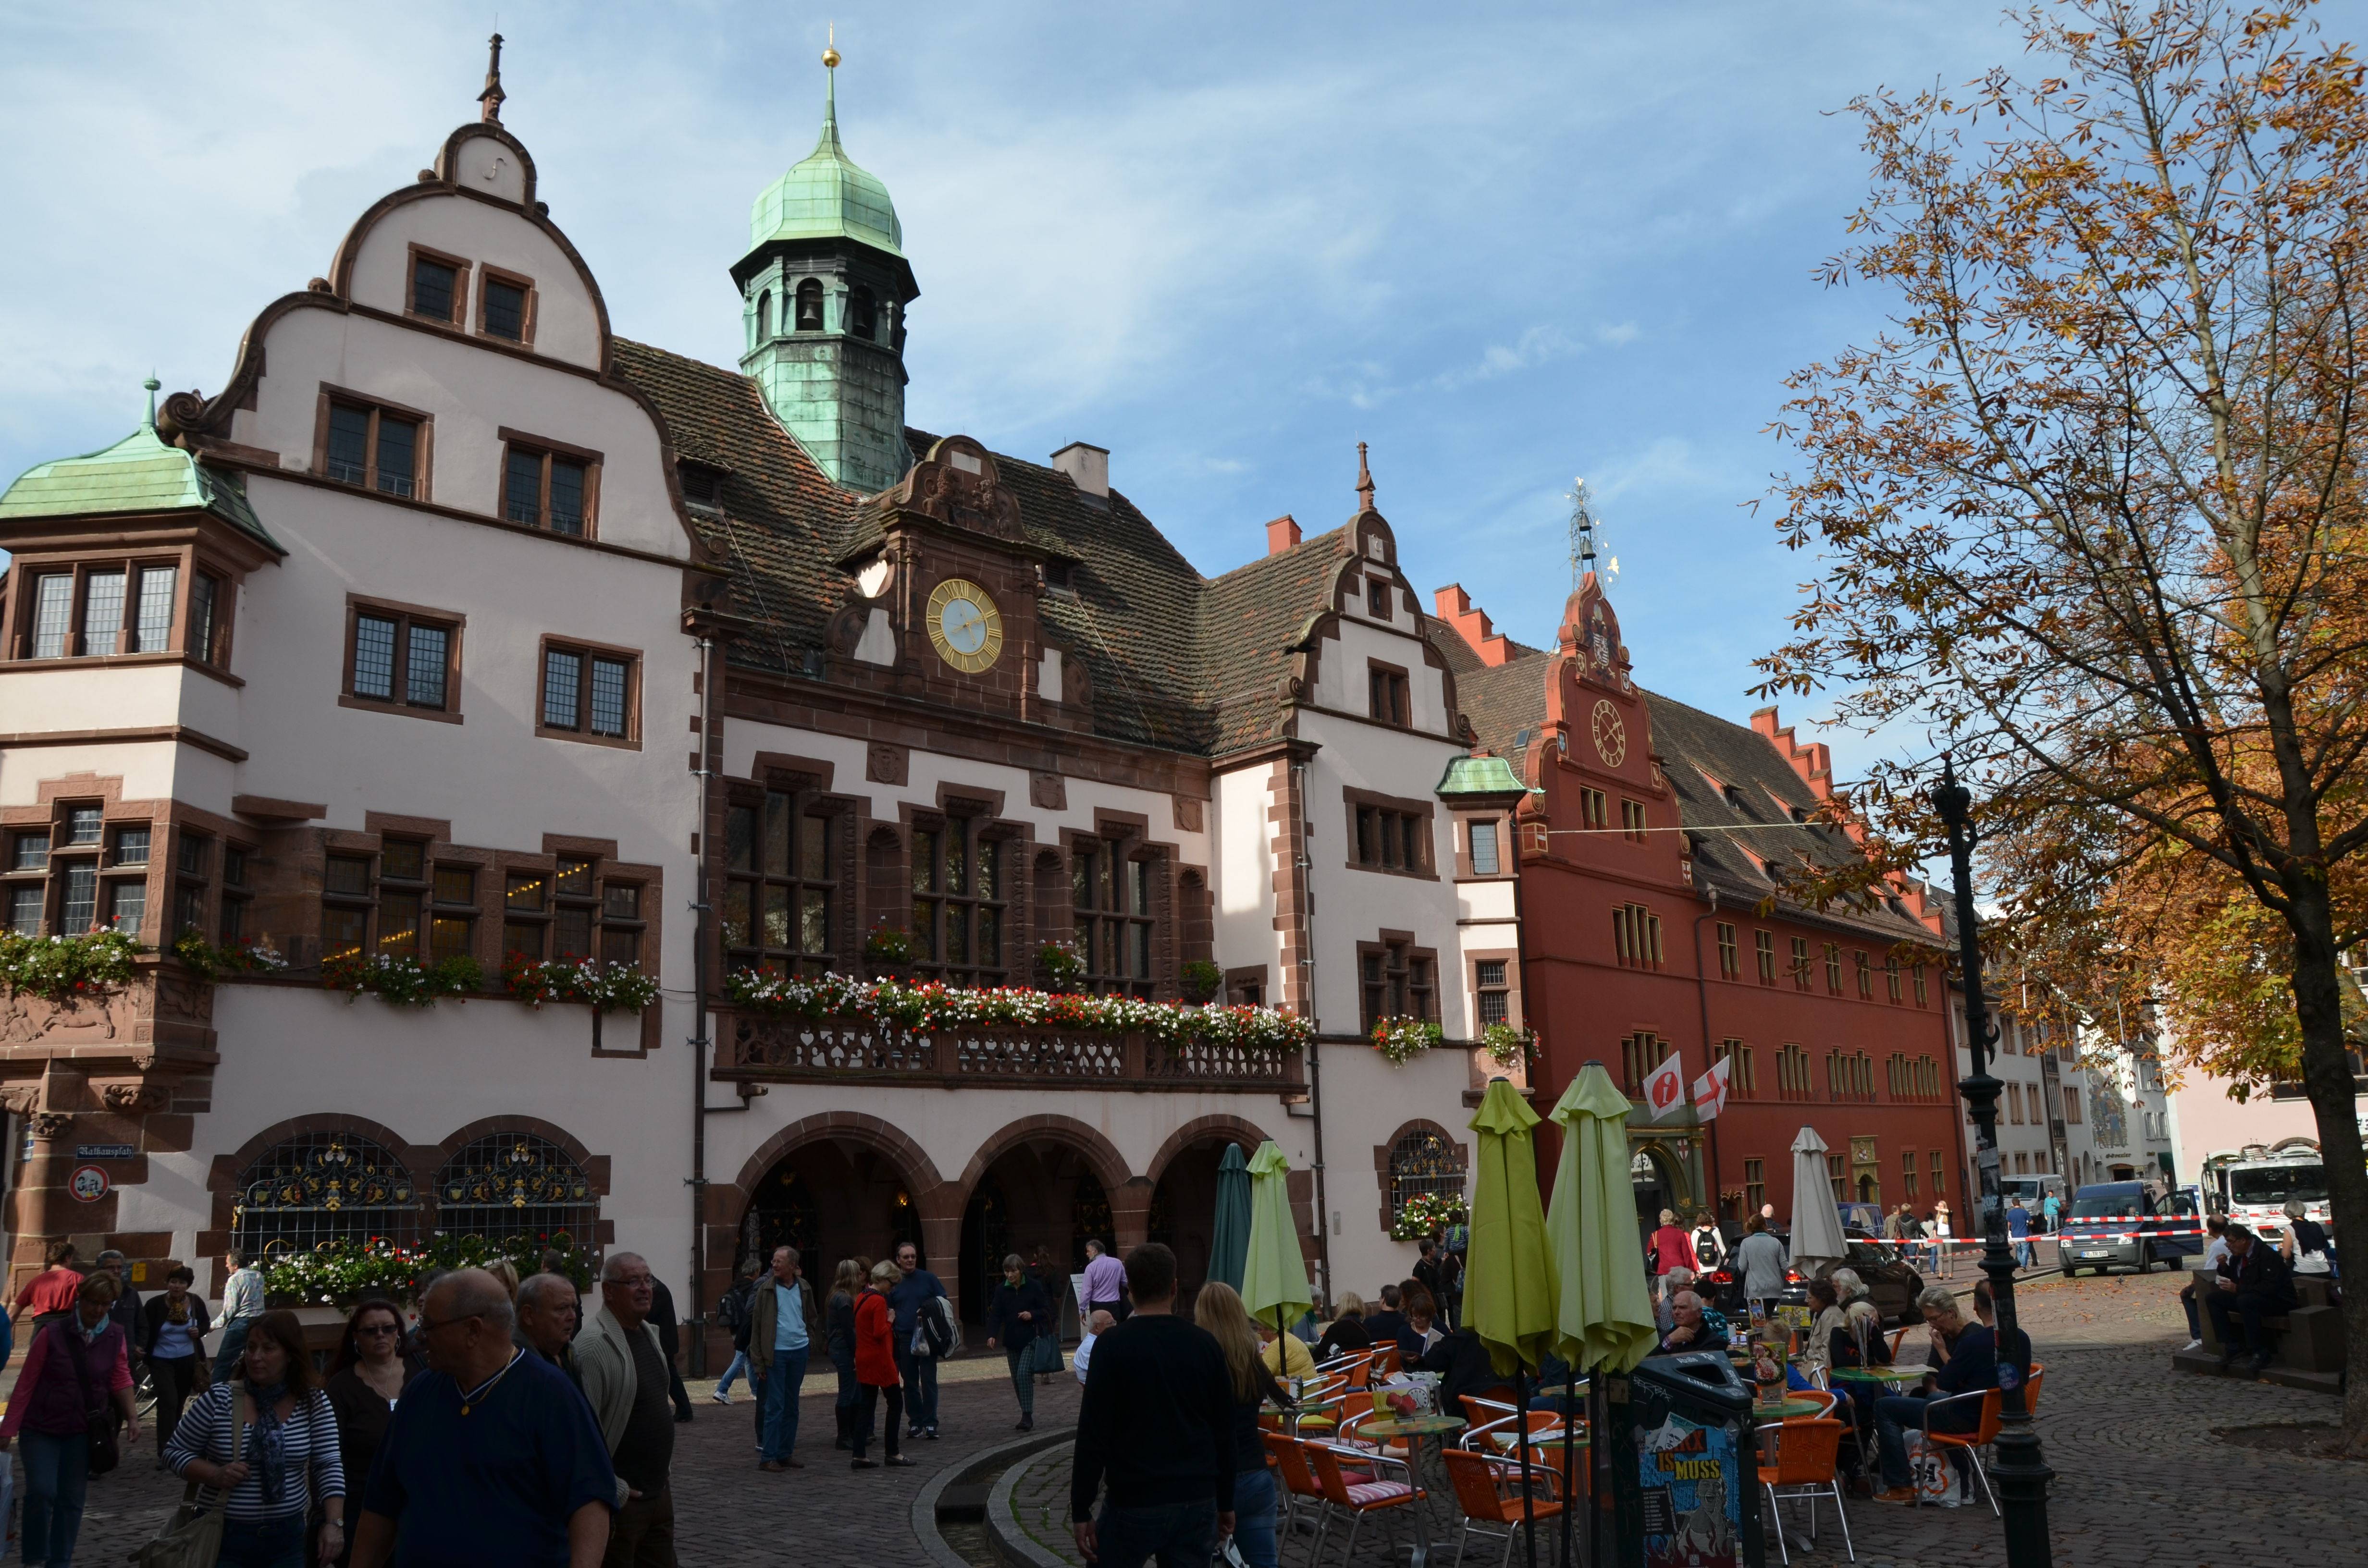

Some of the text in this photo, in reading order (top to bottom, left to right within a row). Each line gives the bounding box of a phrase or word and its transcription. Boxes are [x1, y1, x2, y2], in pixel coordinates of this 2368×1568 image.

[1687, 1377, 1714, 1390] Litter
[1658, 1452, 1675, 1471] IS
[1675, 1459, 1720, 1481] MUSS
